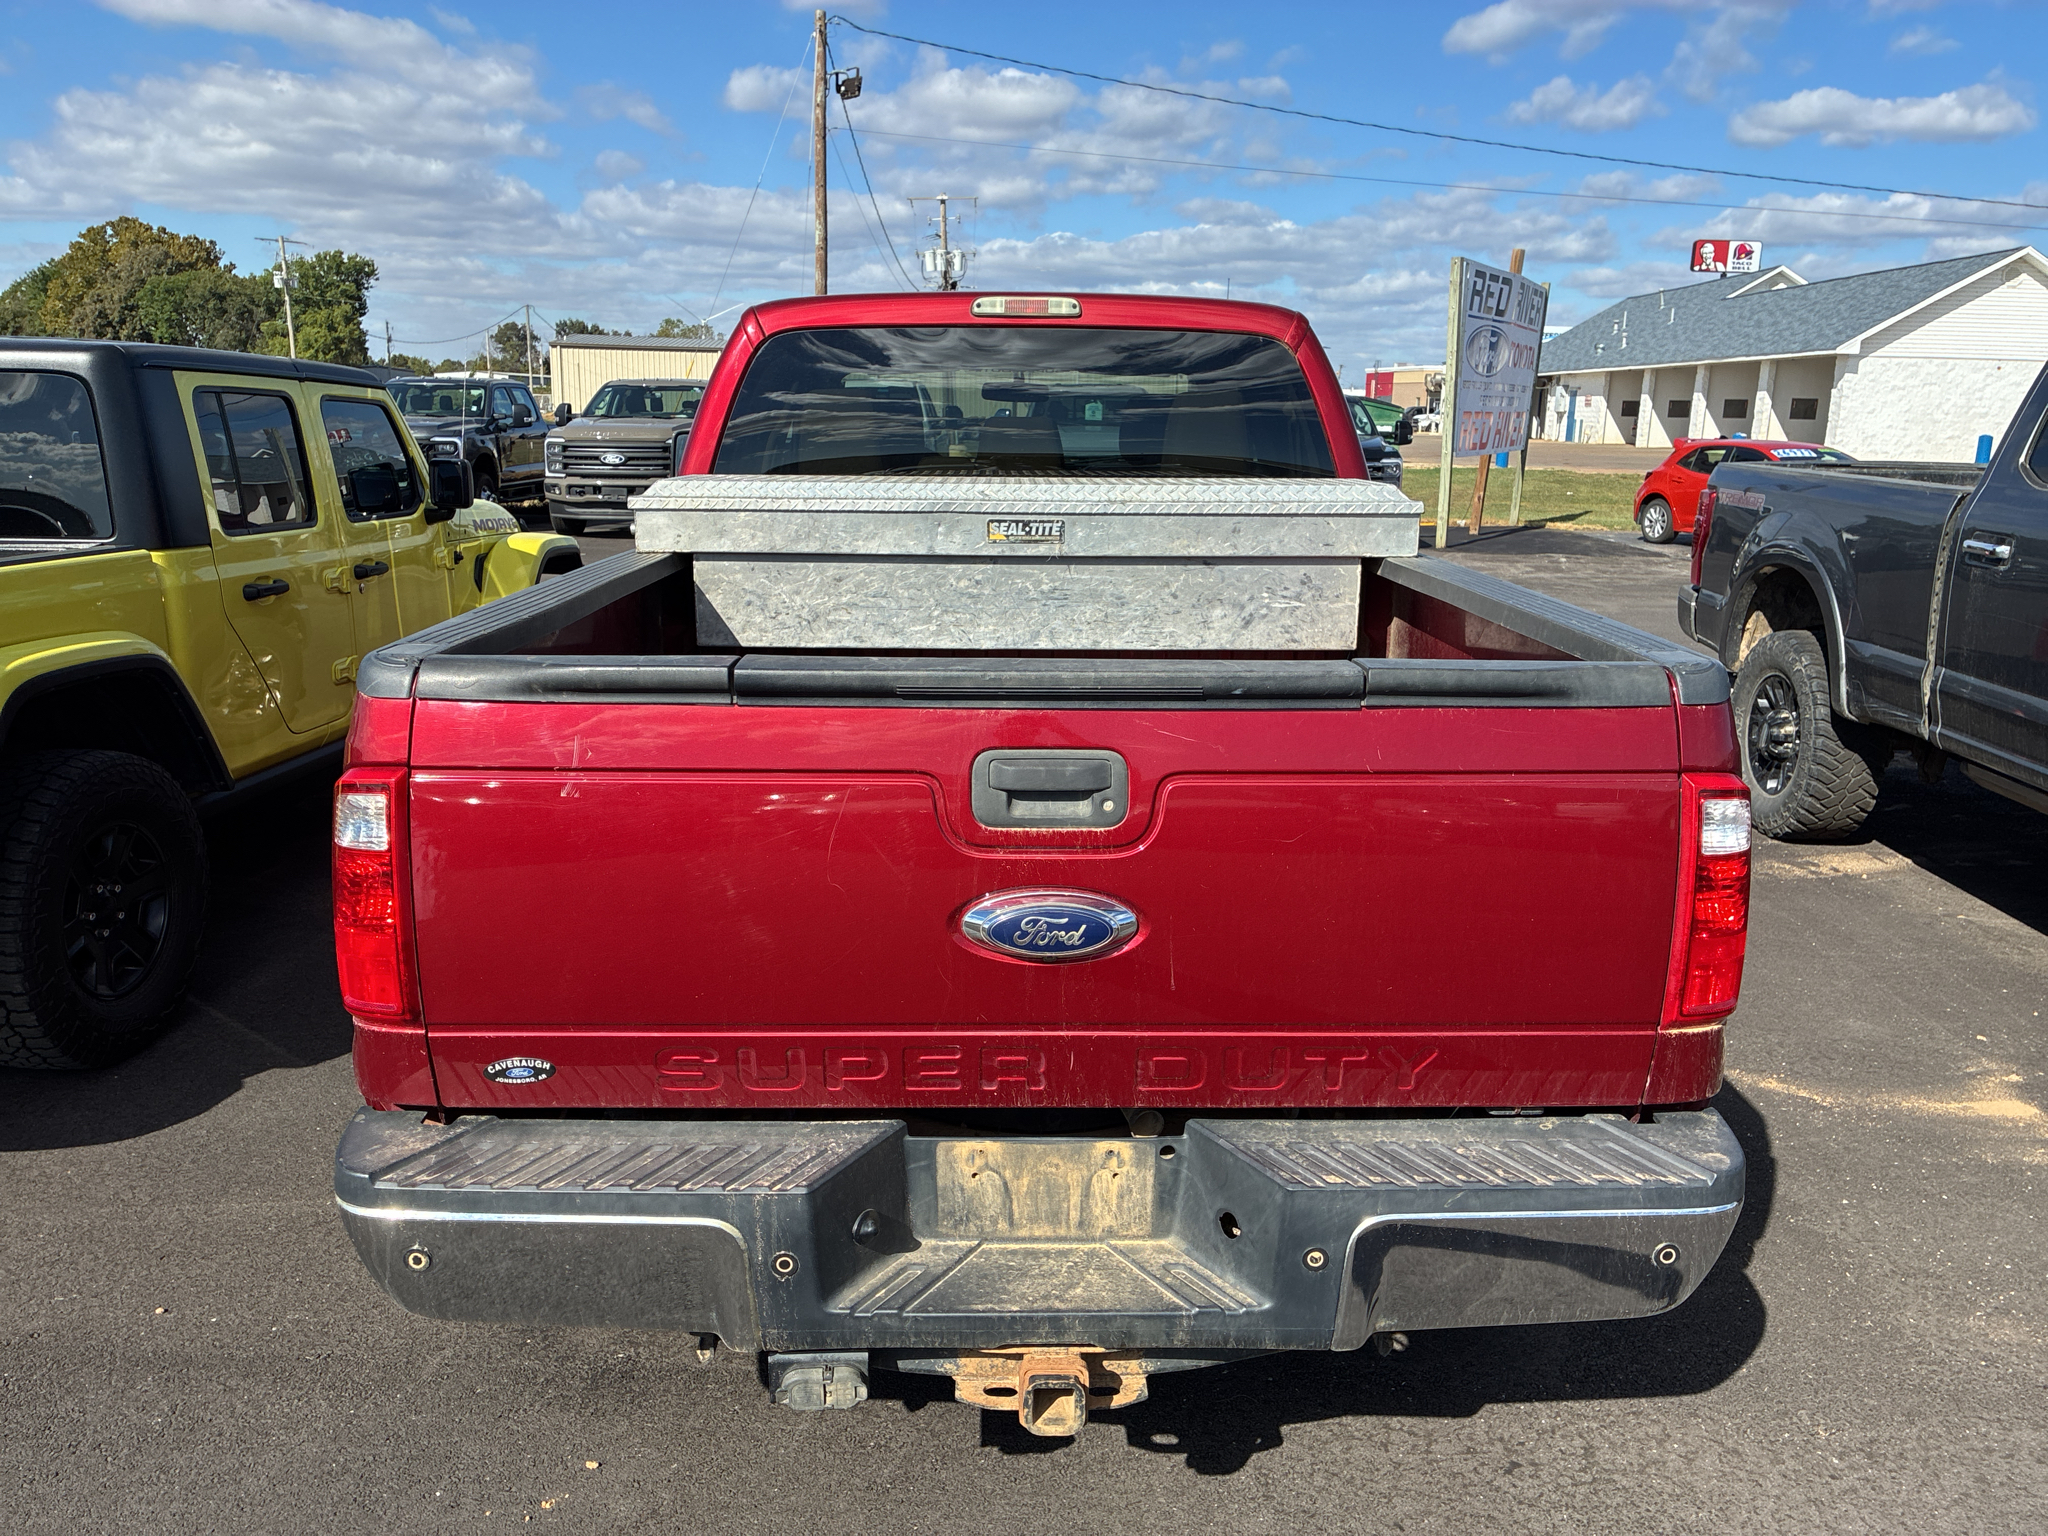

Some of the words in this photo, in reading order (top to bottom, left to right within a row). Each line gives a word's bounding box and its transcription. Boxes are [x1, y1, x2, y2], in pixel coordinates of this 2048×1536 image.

[1468, 269, 1513, 318] RED
[1512, 281, 1544, 328] RIVER
[1509, 341, 1535, 371] TOYOTA
[1458, 411, 1493, 451] RED
[1492, 411, 1526, 449] RIVER
[1718, 488, 1765, 511] TREMOR
[472, 517, 518, 532] MOJAVE
[1013, 916, 1087, 946] Ford
[487, 1059, 551, 1074] CAVENAUGH
[495, 1076, 538, 1084] JONESBORO,
[538, 1073, 548, 1081] AR
[654, 1045, 1048, 1091] SUPER
[1136, 1046, 1440, 1091] DUTY
